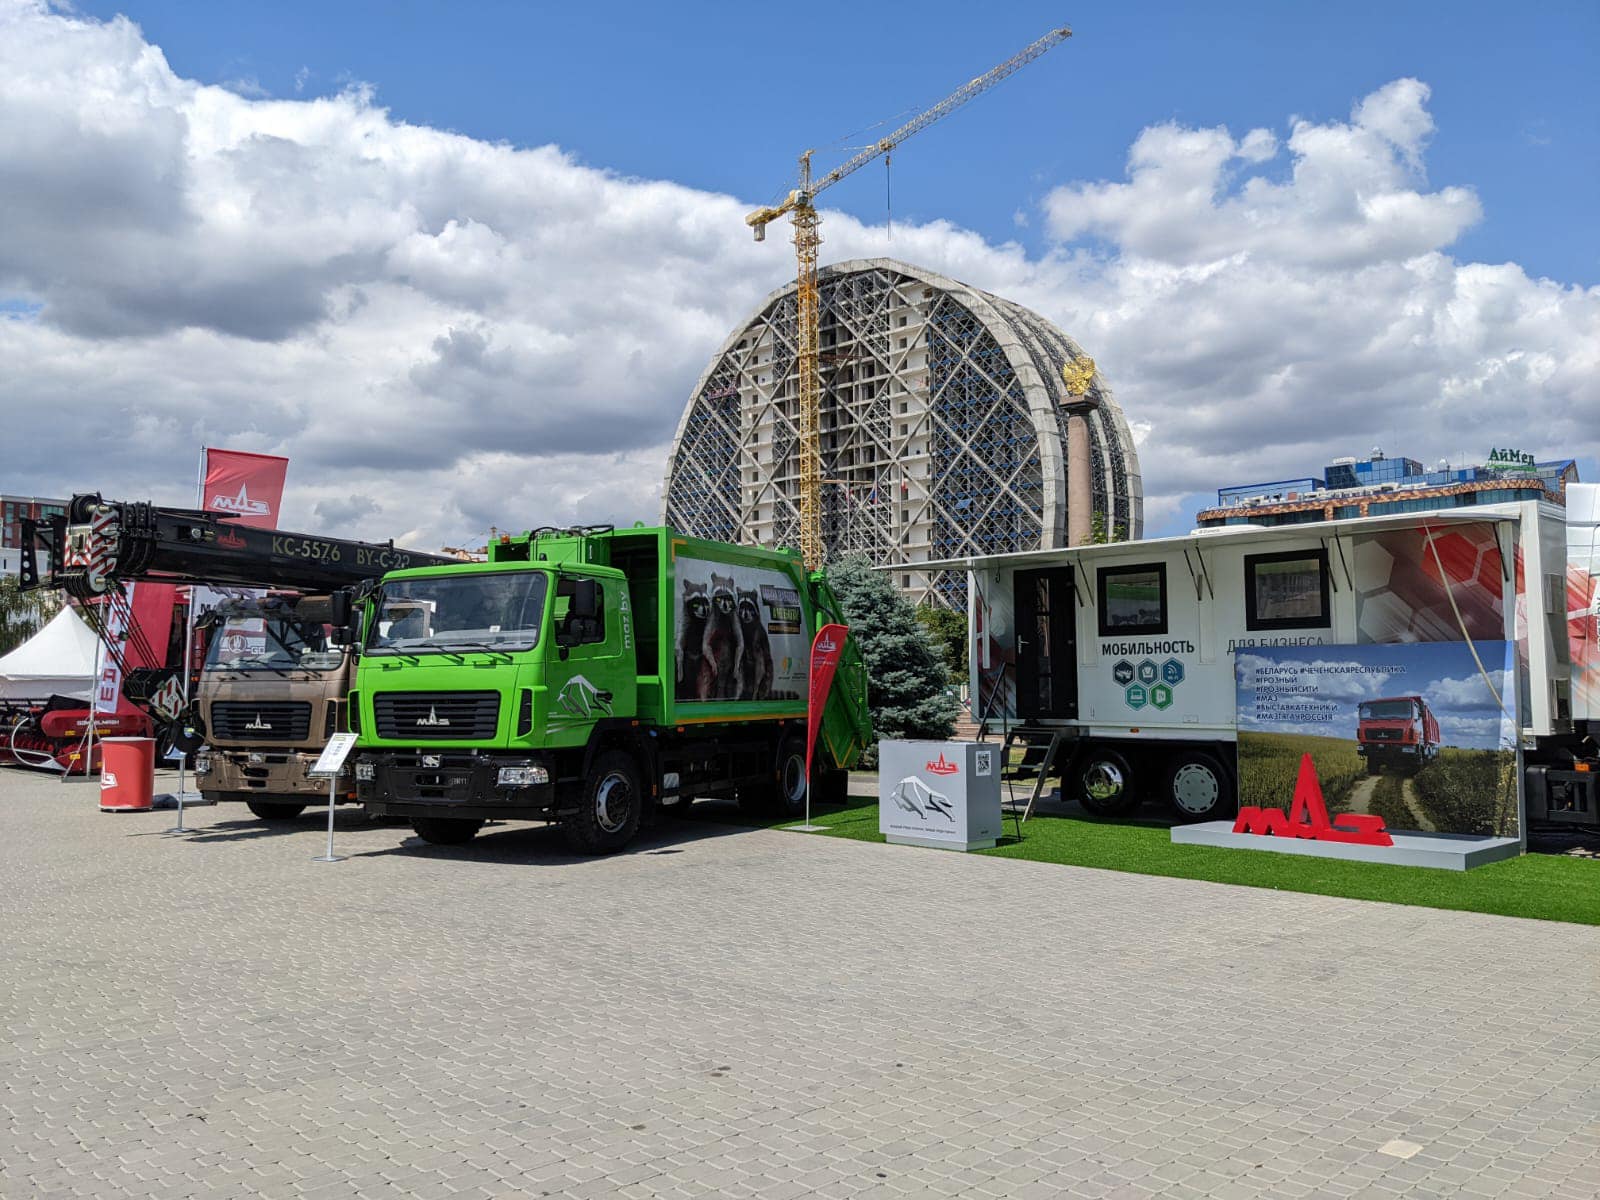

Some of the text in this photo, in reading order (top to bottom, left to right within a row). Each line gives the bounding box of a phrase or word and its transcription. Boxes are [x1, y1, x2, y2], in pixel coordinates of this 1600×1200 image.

[1488, 447, 1535, 467] АйМед
[1102, 641, 1195, 656] МОБИЛЬНОСТЬ
[1255, 666, 1298, 676] #БЕЛАРУСЬ
[1255, 675, 1298, 684] #ГРОЗНЫЙ
[1256, 684, 1319, 693] #ГРОЗНЫЙСИТИ
[1256, 694, 1279, 702] #МАЗ
